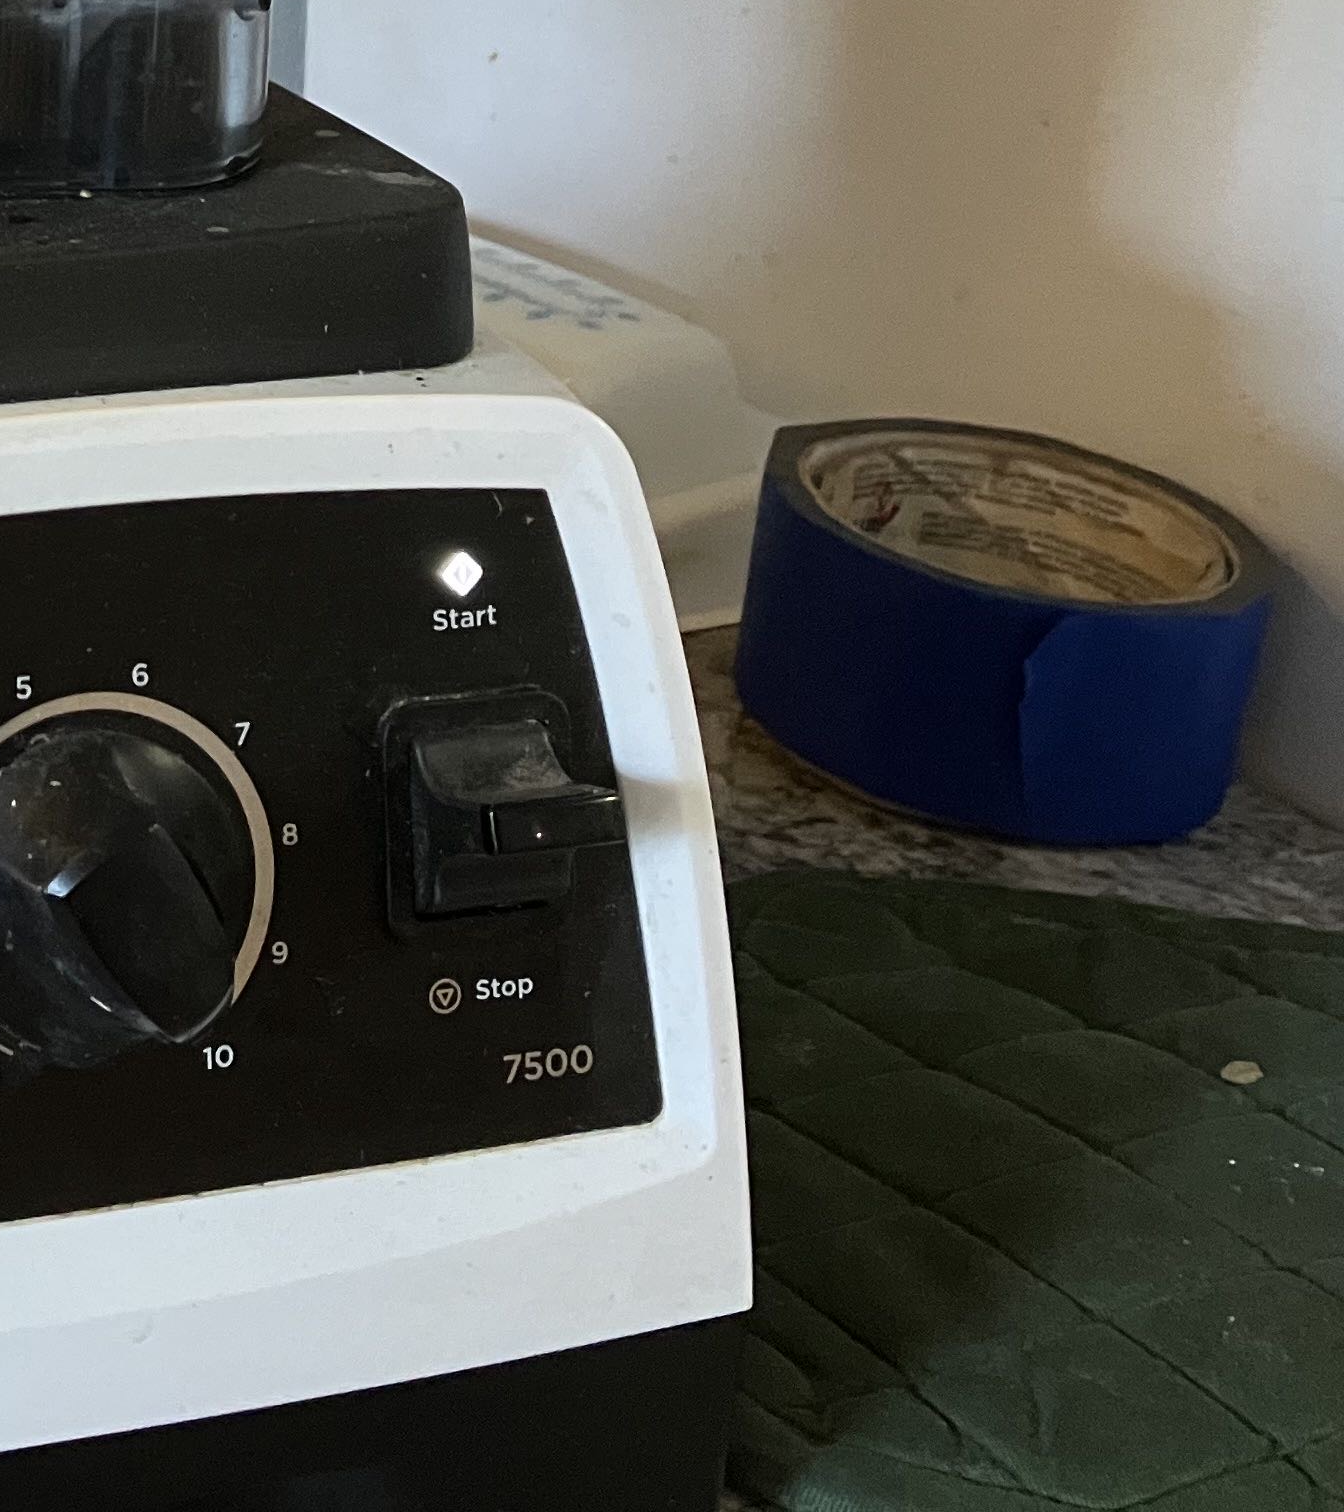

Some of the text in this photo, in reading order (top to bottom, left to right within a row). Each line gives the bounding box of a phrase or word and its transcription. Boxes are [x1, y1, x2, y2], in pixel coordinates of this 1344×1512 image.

[432, 604, 498, 631] Start
[131, 663, 149, 687] 6
[16, 676, 32, 699] 5
[234, 722, 251, 747] 7
[282, 823, 298, 847] 8
[271, 942, 288, 965] 9
[475, 973, 534, 1001] Stop
[202, 1045, 234, 1069] 10
[503, 1044, 593, 1084] 7500
